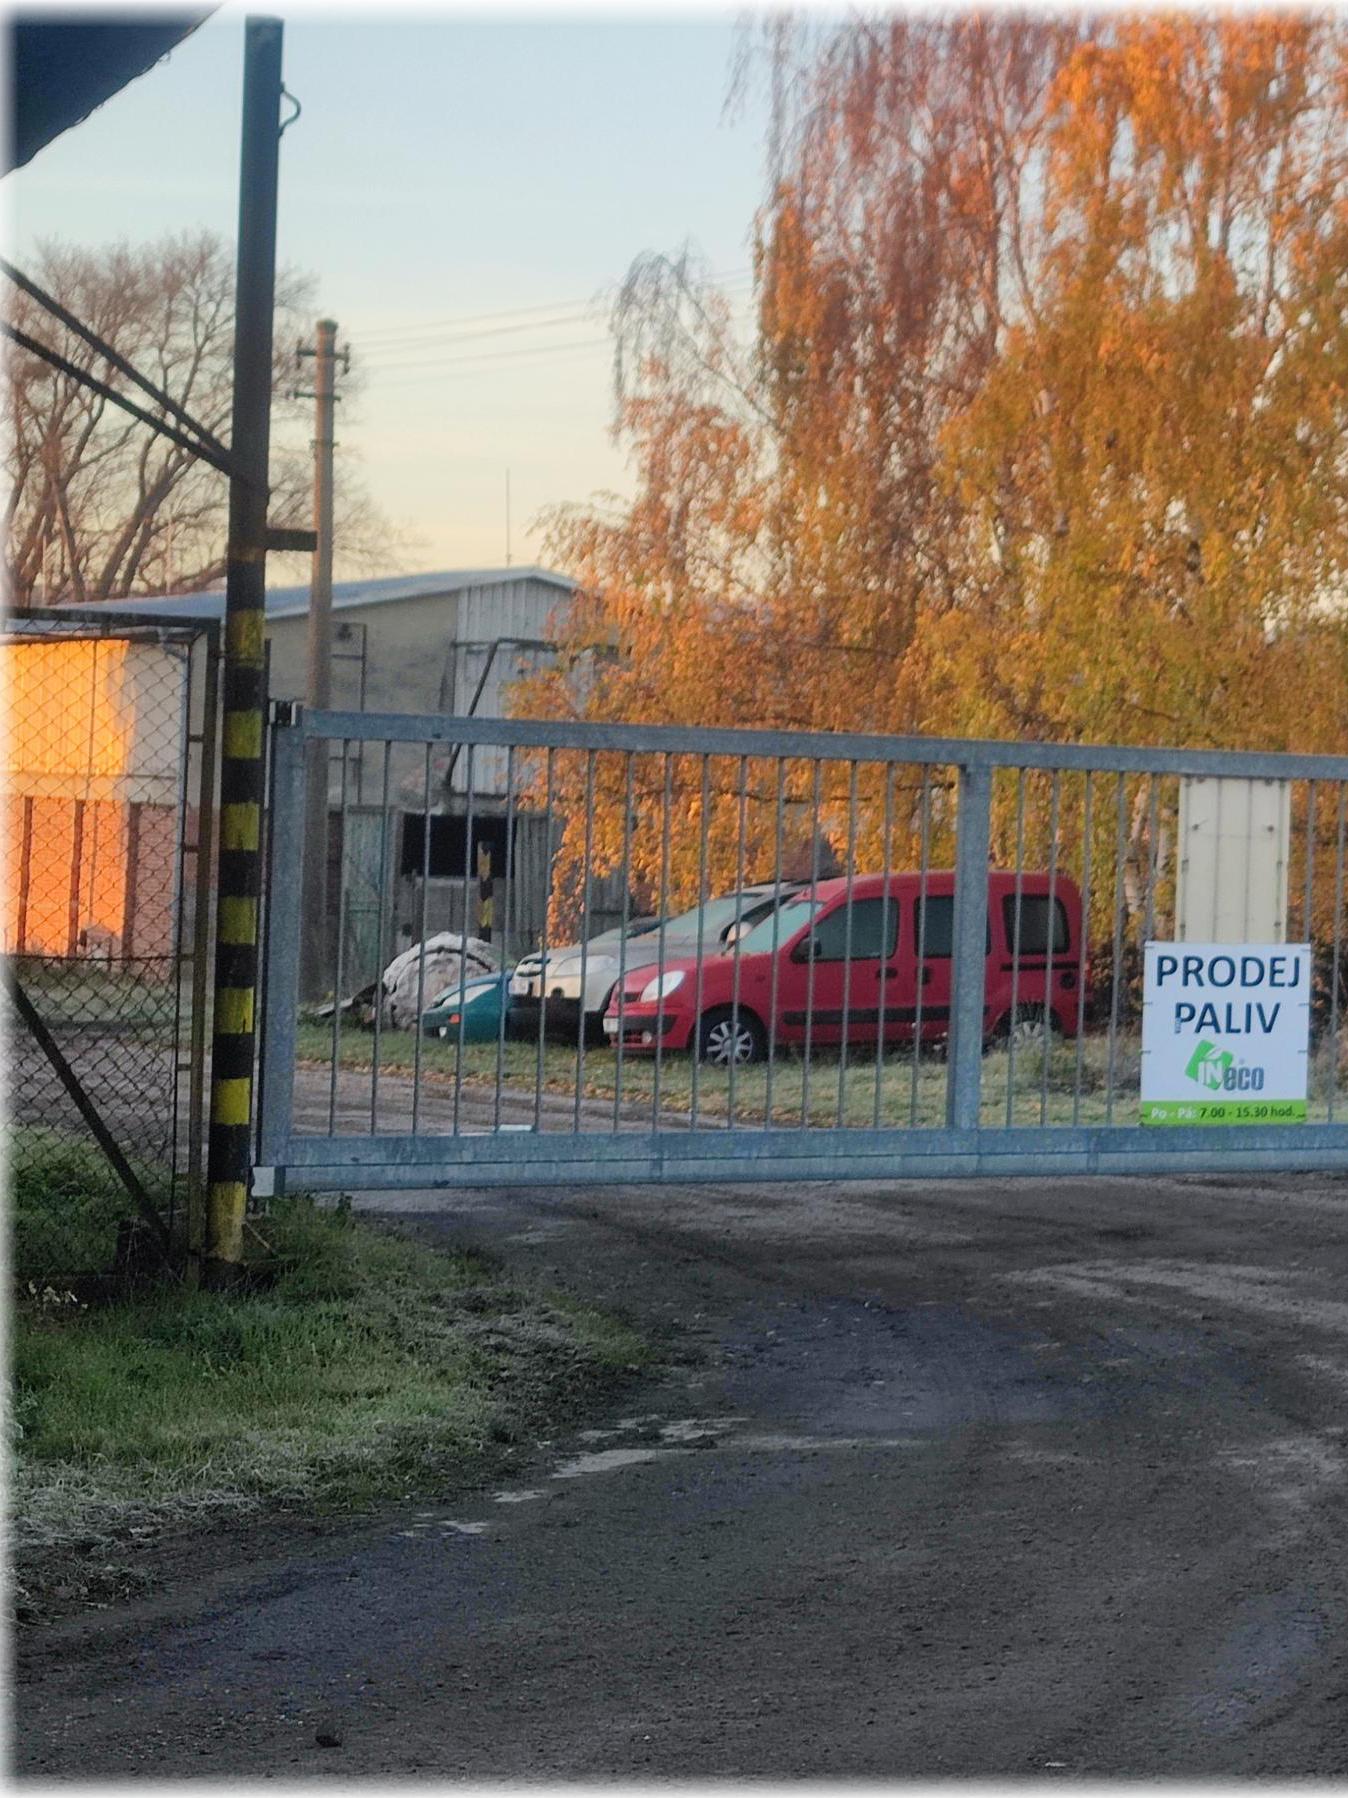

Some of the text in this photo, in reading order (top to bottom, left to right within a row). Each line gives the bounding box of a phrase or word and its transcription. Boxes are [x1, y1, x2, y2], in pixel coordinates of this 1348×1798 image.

[1156, 955, 1300, 988] PRODEJ
[1174, 1002, 1281, 1034] PALIV
[1200, 1106, 1225, 1118] 7.00
[1236, 1105, 1268, 1118] 15.30
